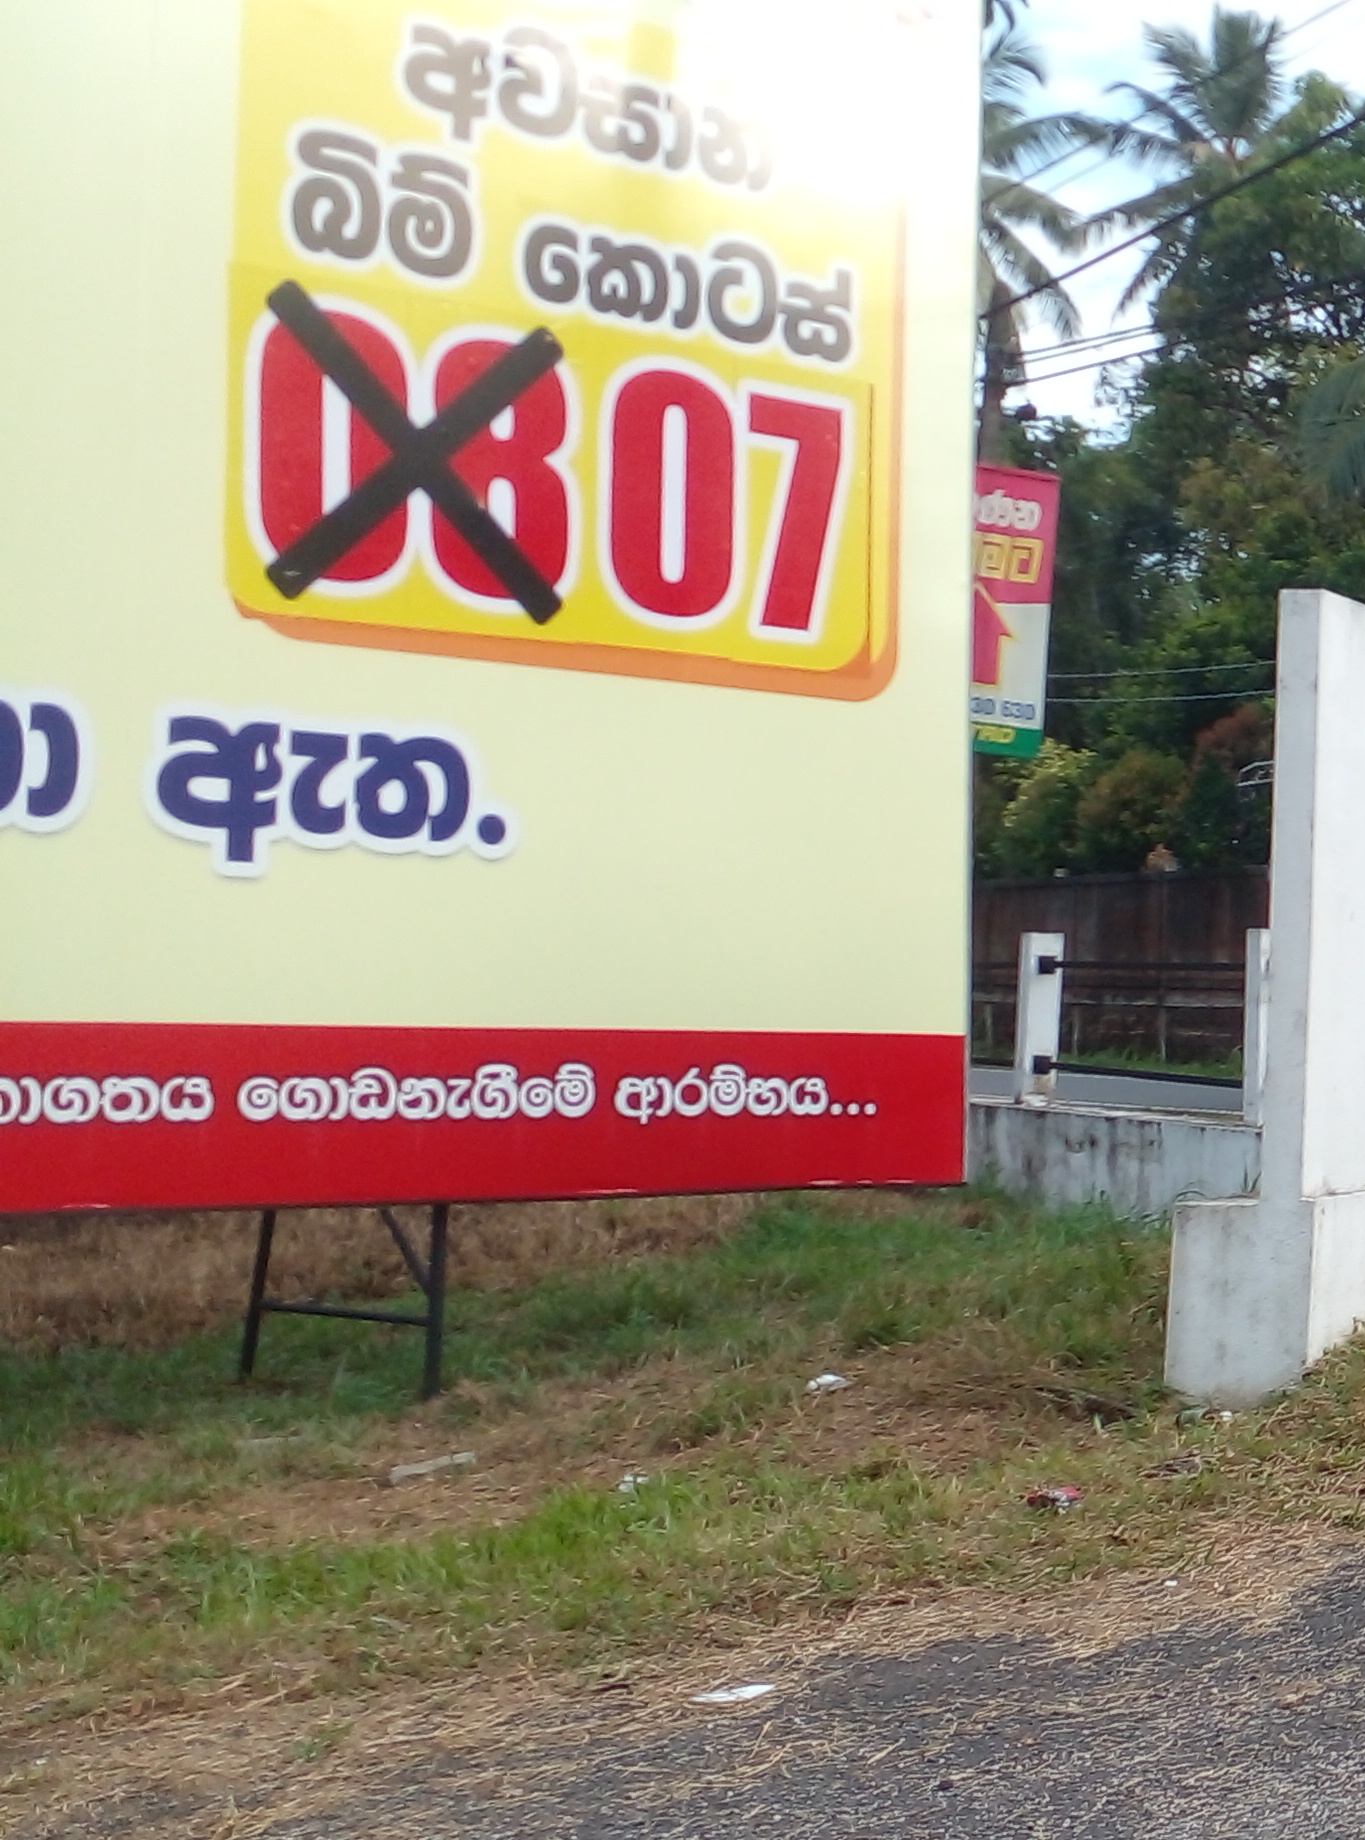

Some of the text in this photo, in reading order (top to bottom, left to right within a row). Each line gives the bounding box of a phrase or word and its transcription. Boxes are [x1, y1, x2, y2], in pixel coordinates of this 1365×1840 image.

[291, 128, 852, 363] බිම් කොටස්
[611, 369, 843, 631] 07
[156, 715, 508, 862] ඇත.
[237, 1062, 597, 1121] ගොඩනැගීමේ
[614, 1063, 878, 1126] ආරම්භය...
